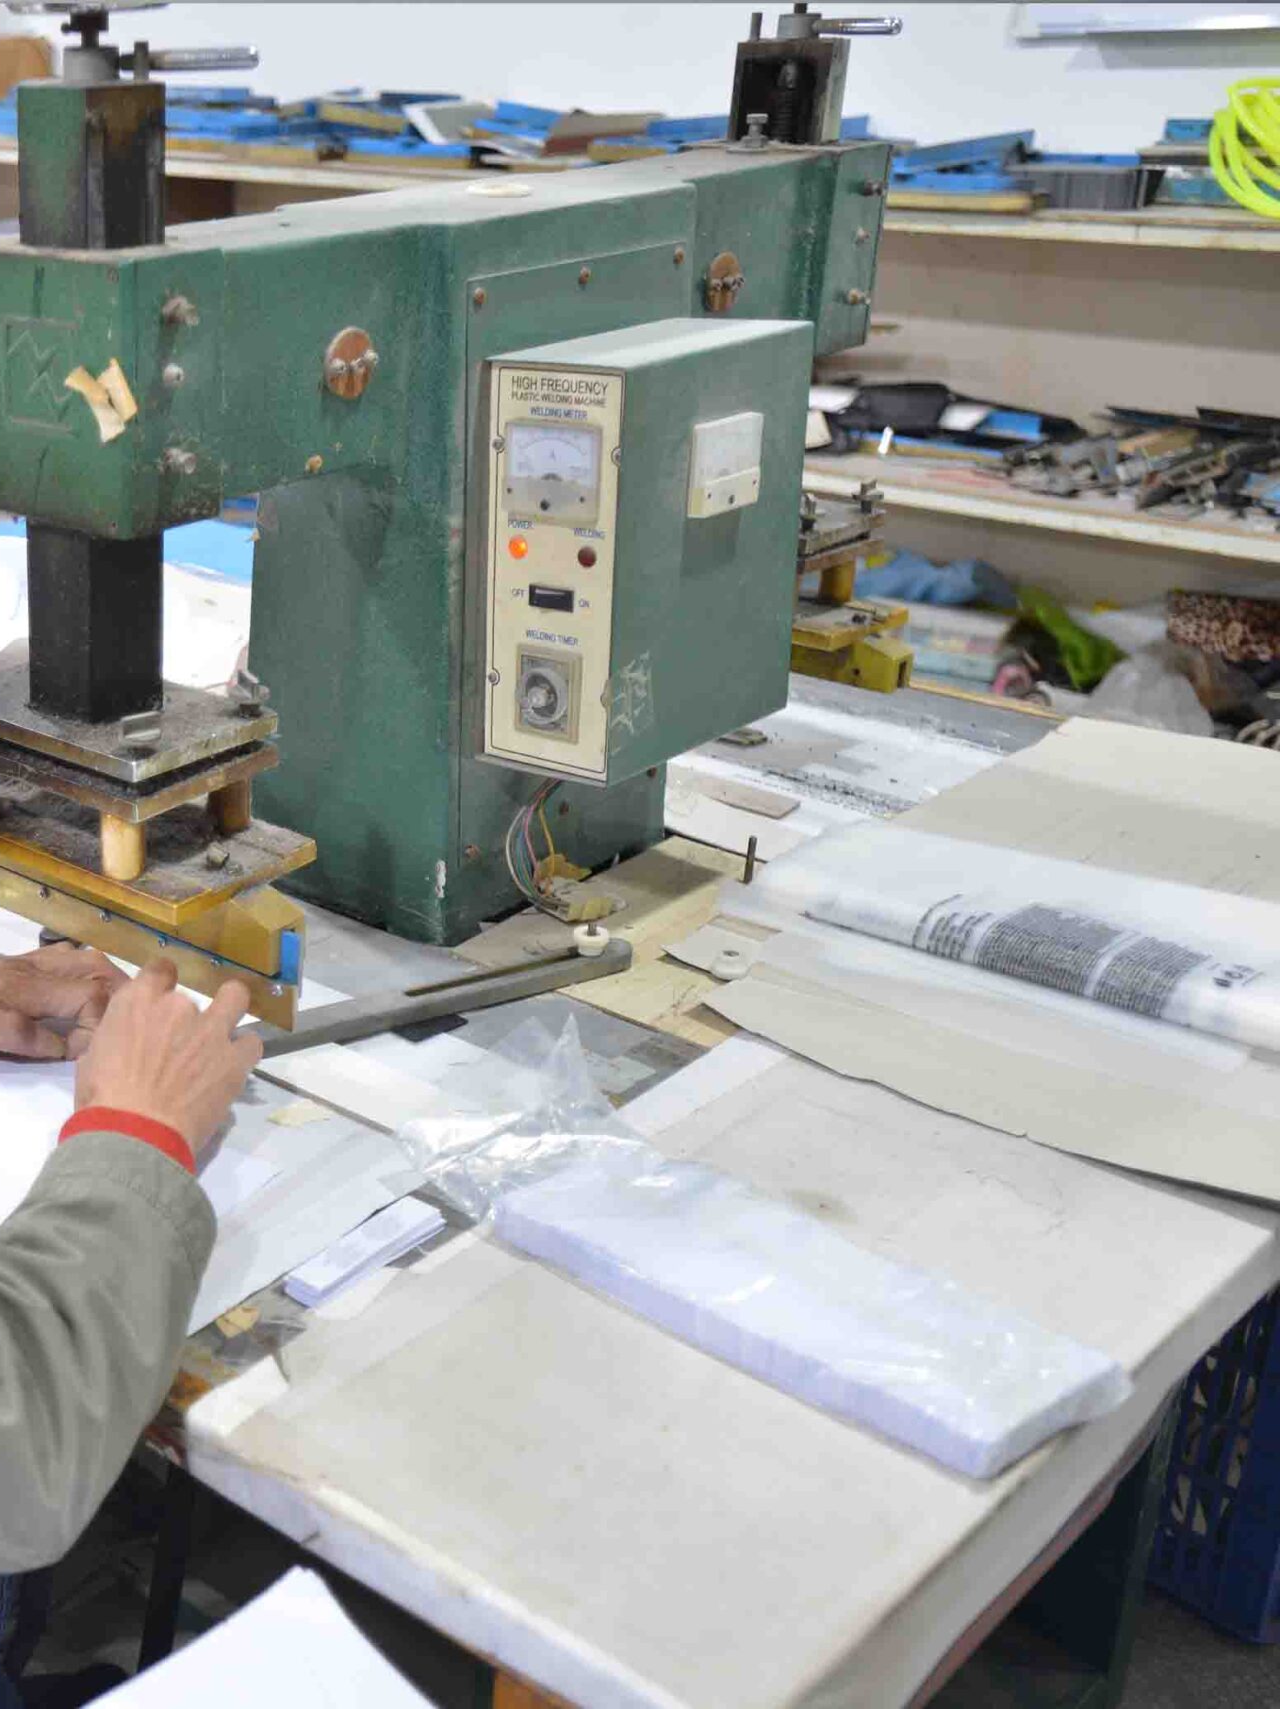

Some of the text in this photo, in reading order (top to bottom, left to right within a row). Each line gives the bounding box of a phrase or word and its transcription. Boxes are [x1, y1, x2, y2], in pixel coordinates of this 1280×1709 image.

[511, 375, 609, 396] HIGH FREQUENCY
[511, 391, 607, 408] PLASTIC WELDING MACHINE
[530, 406, 588, 420] WELDING METER
[507, 520, 534, 530] POWER
[572, 527, 606, 540] WELDING
[511, 588, 525, 598] OFF
[578, 598, 590, 608] ON
[526, 629, 557, 642] WELDING
